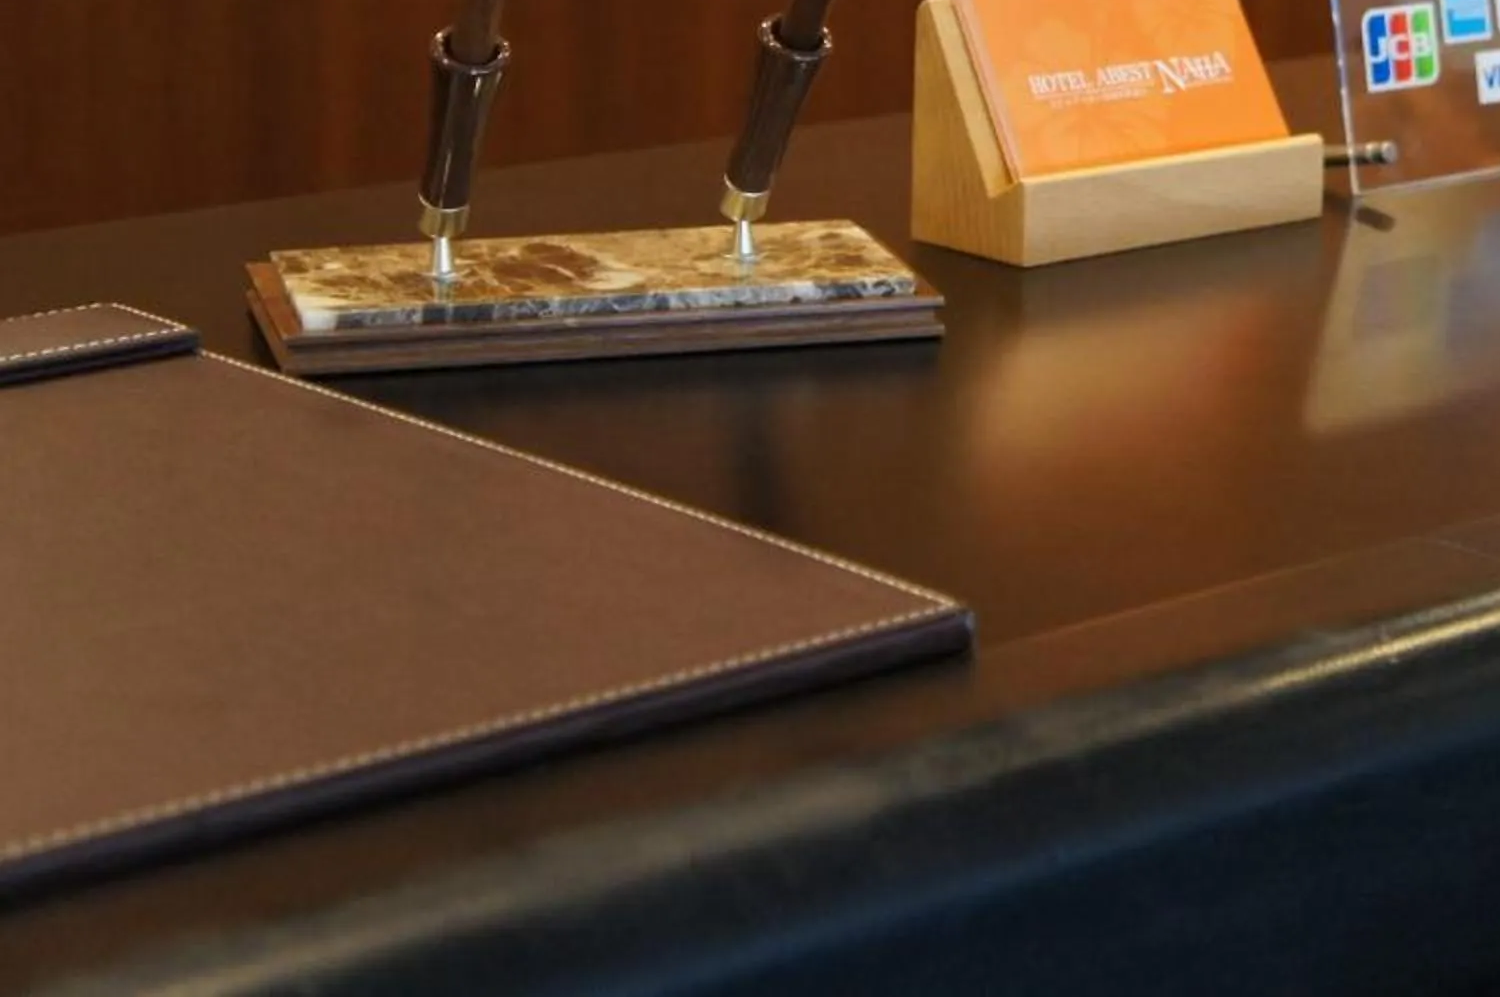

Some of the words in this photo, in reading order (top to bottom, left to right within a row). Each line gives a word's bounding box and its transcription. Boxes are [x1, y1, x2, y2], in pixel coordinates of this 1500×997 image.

[1028, 69, 1087, 95] HOTEL
[1096, 61, 1153, 86] ABEST
[1153, 50, 1233, 95] NAHA
